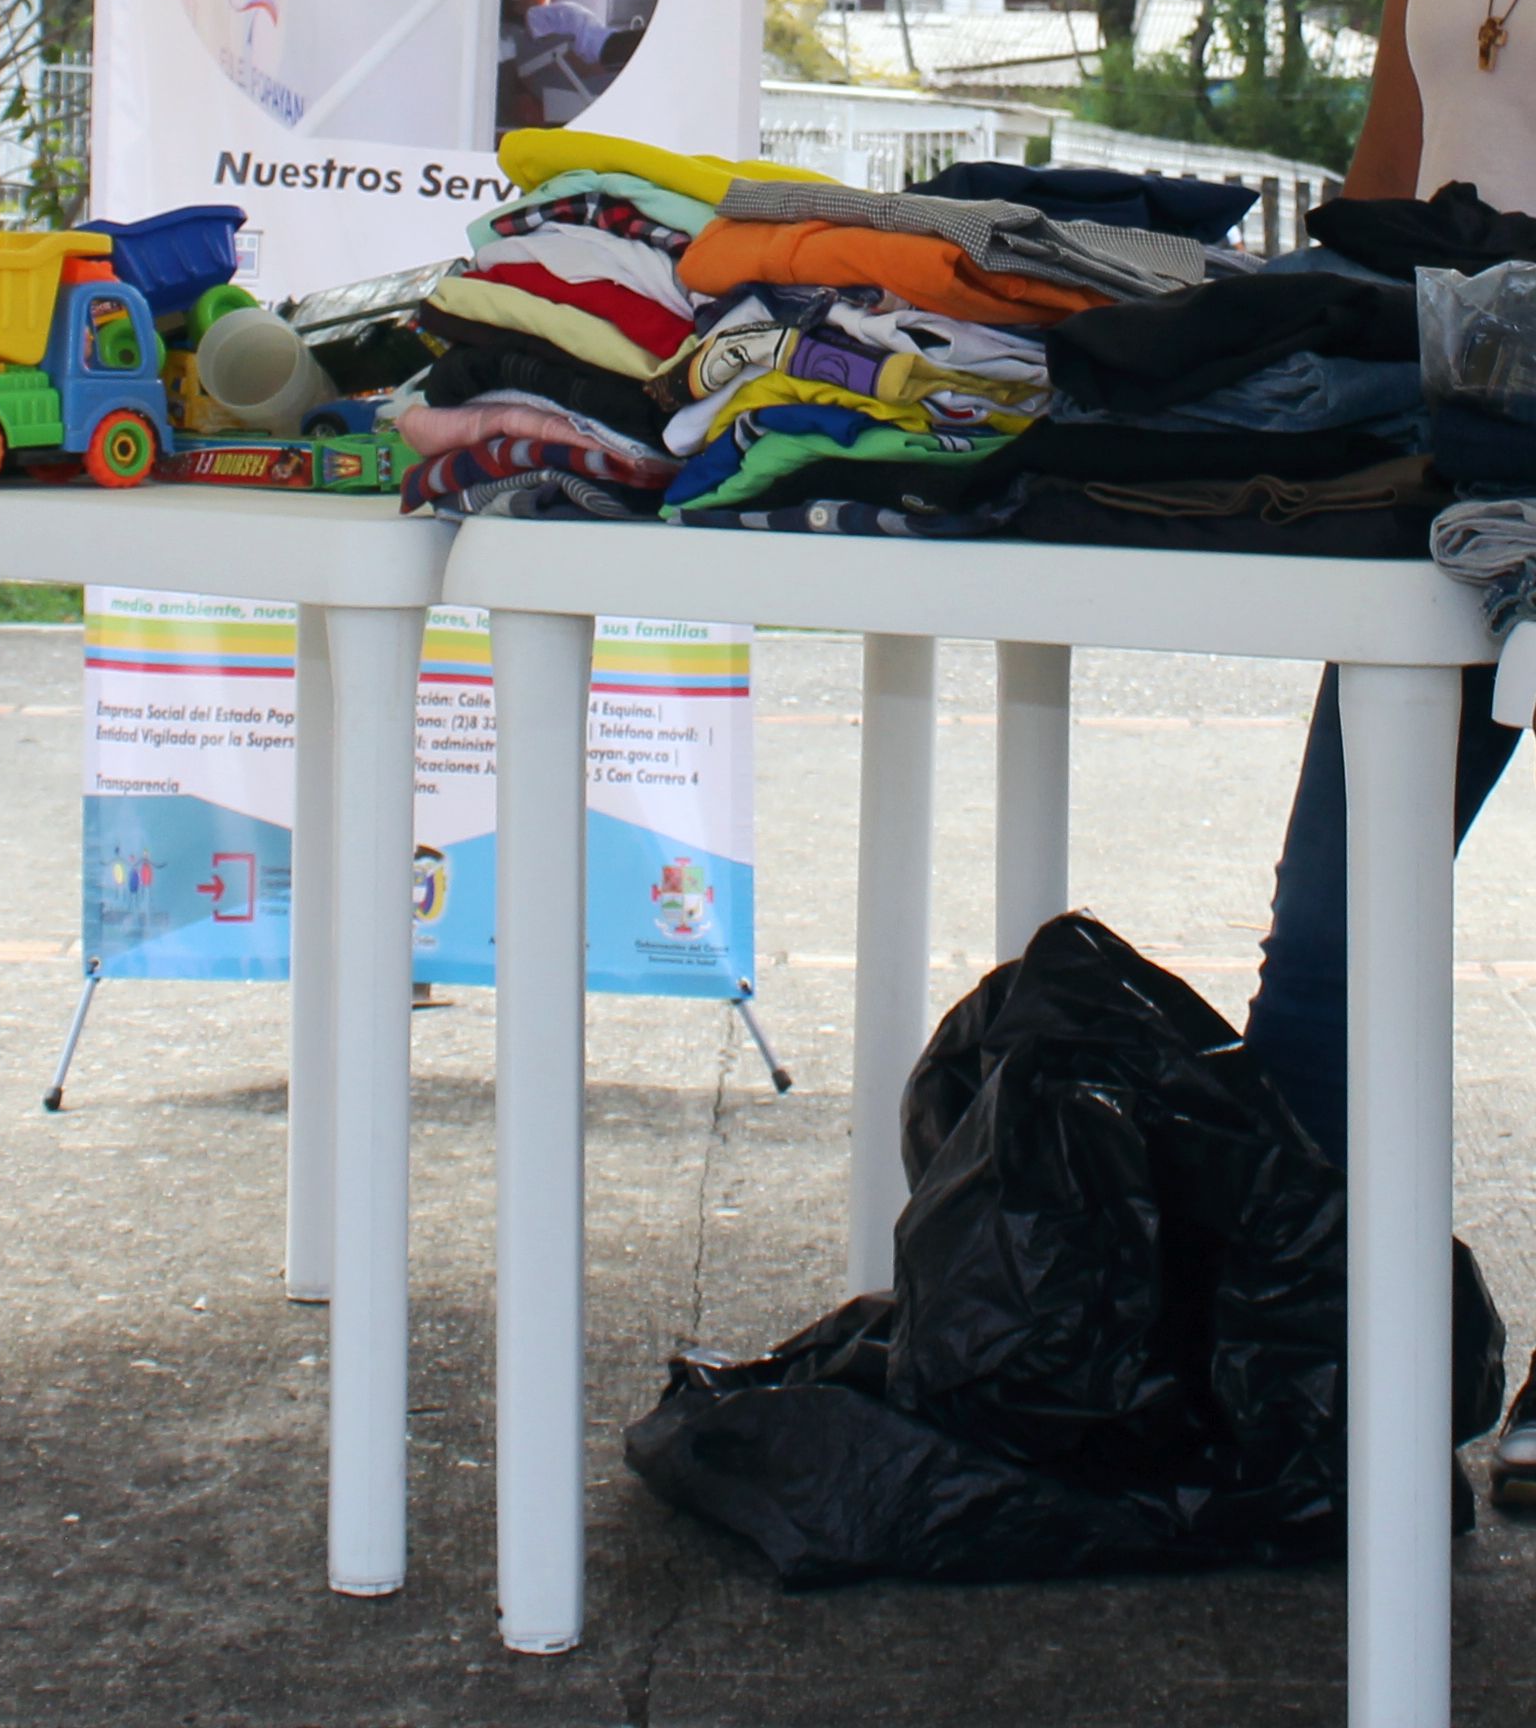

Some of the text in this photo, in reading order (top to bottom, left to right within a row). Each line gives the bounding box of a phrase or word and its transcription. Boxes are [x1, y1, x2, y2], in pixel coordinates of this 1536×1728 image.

[213, 150, 522, 202] Nuestros Serv
[110, 597, 153, 613] medio
[158, 599, 247, 620] ambiente,
[252, 606, 298, 620] nues
[601, 623, 630, 637] sus
[635, 621, 709, 639] familias
[96, 700, 296, 728] Empresa Social del Estado Pop
[458, 693, 492, 709] Calle
[589, 701, 599, 715] 4
[602, 701, 657, 720] Esquina.
[95, 725, 296, 750] Entidad Vigilada por la Supers
[430, 738, 497, 753] administr
[599, 723, 654, 742] Teléfono
[657, 727, 700, 744] móvil:
[95, 772, 181, 796] Transparencia
[483, 758, 497, 775] Ju
[592, 768, 603, 783] 5
[606, 768, 633, 783] Con
[636, 769, 687, 786] Carrera
[690, 771, 700, 786] 4
[415, 781, 441, 795] ina.
